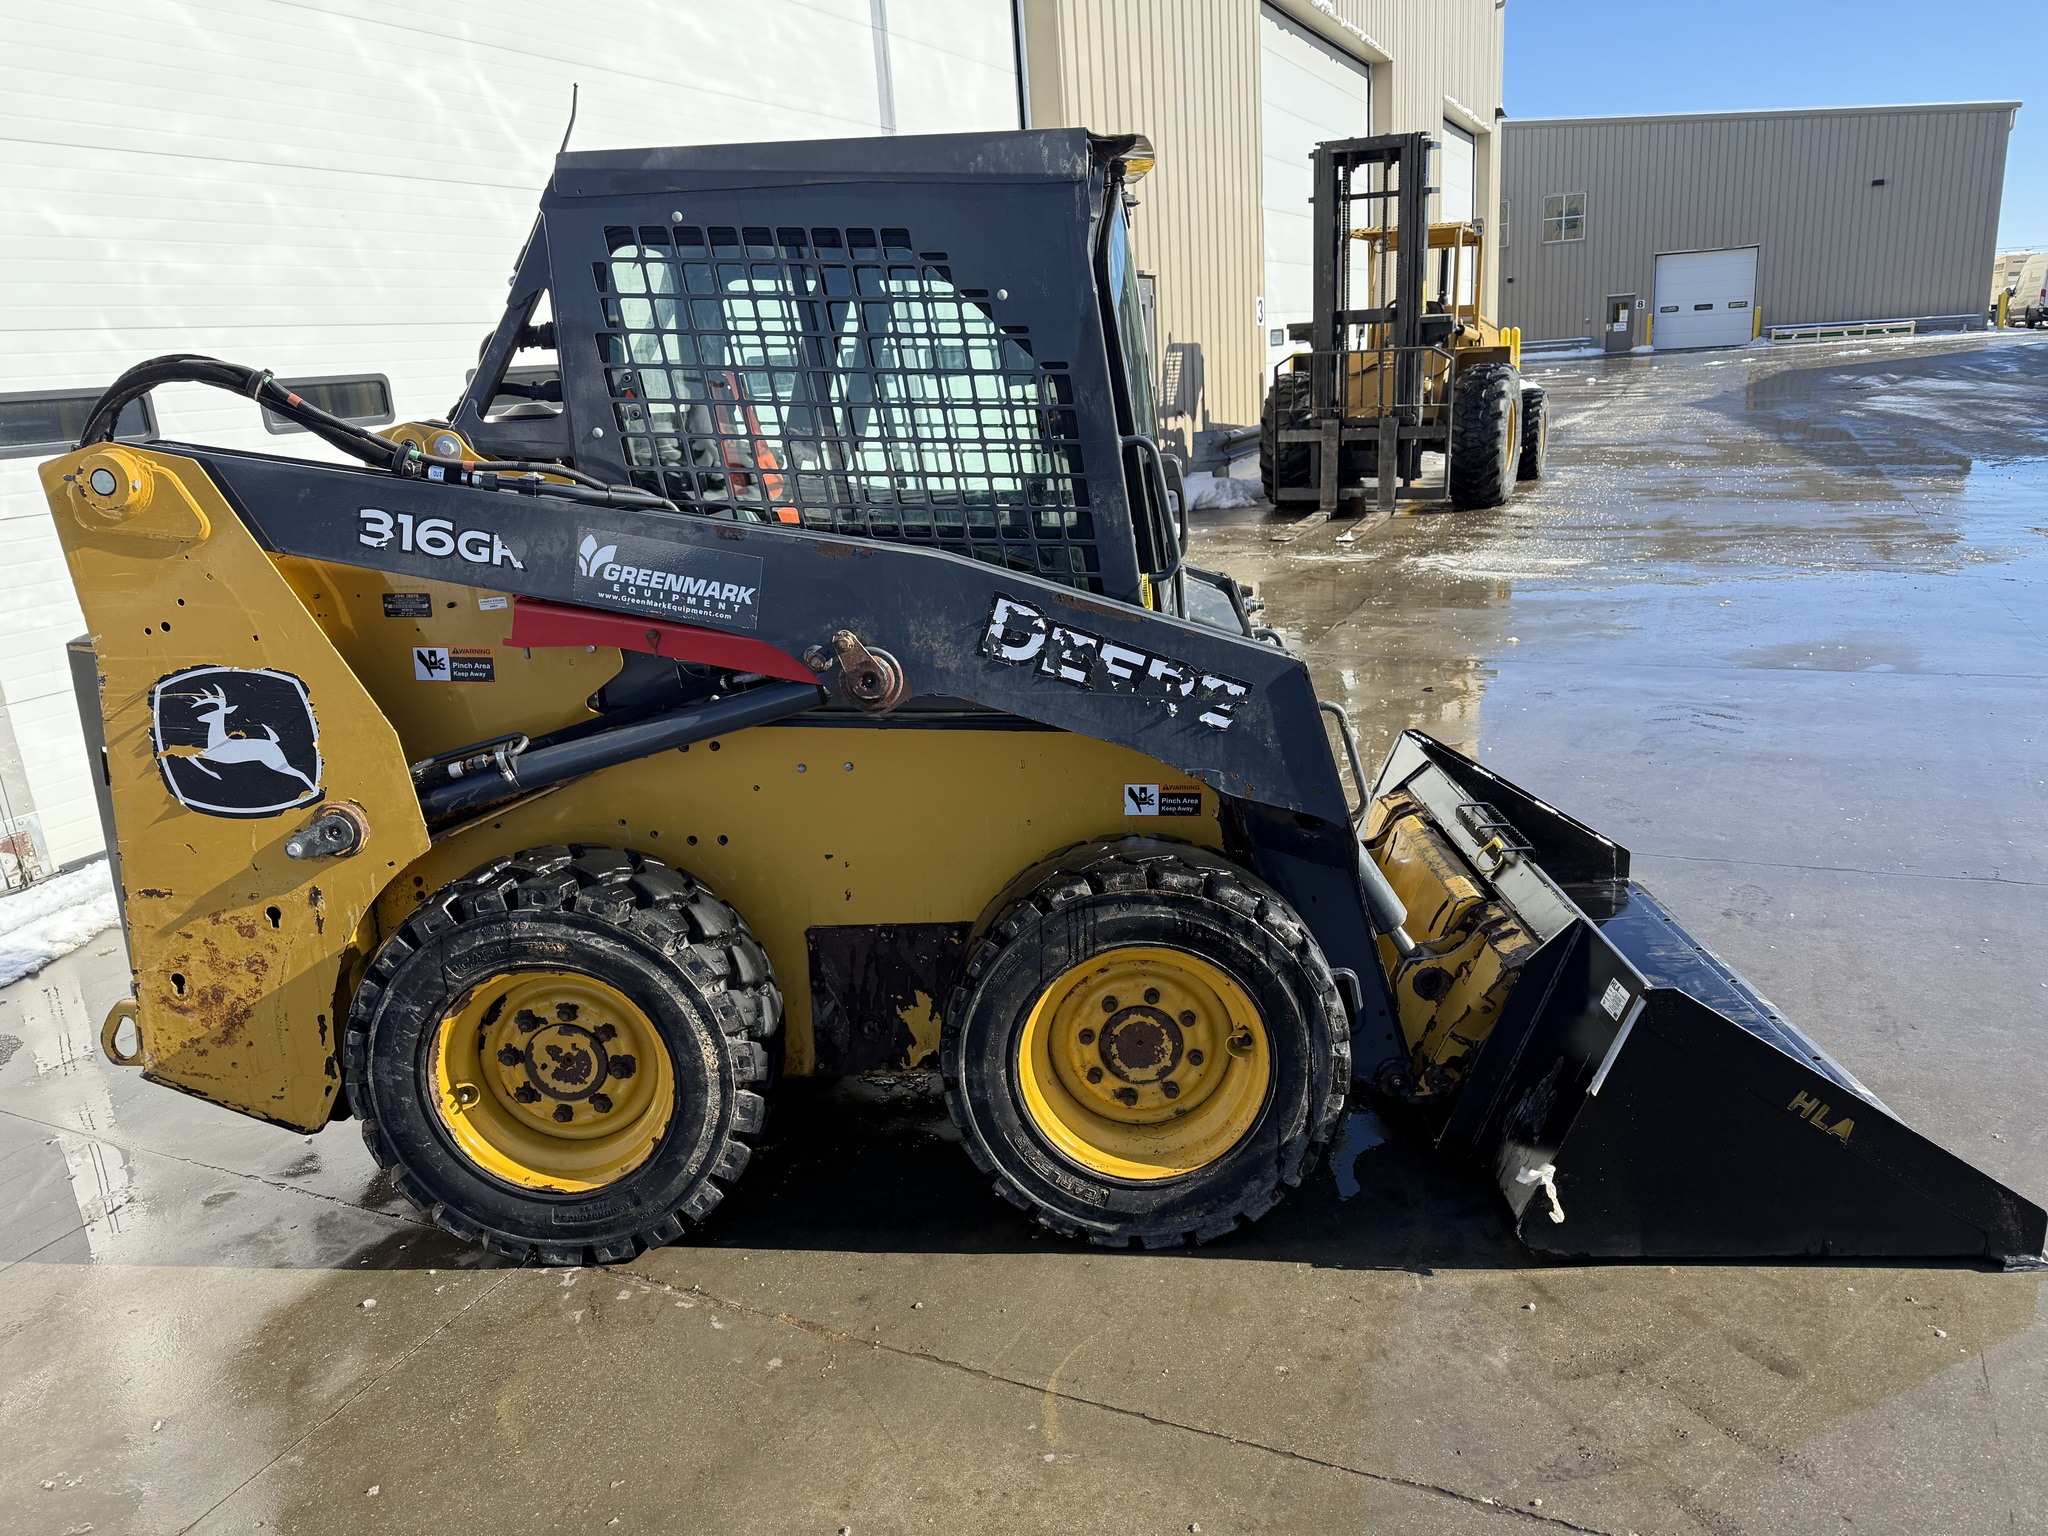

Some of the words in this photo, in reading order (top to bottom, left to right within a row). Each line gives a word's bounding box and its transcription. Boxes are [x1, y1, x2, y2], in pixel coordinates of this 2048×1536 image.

[1257, 299, 1264, 324] 3
[1637, 300, 1644, 308] 8
[432, 470, 443, 478] OUT
[602, 563, 757, 605] GREENMARK
[597, 591, 733, 620] www.GreenMarkEquipment.com
[613, 584, 741, 613] EQUIPMENT
[1611, 980, 1621, 993] HLA
[1787, 1089, 1856, 1146] HLA
